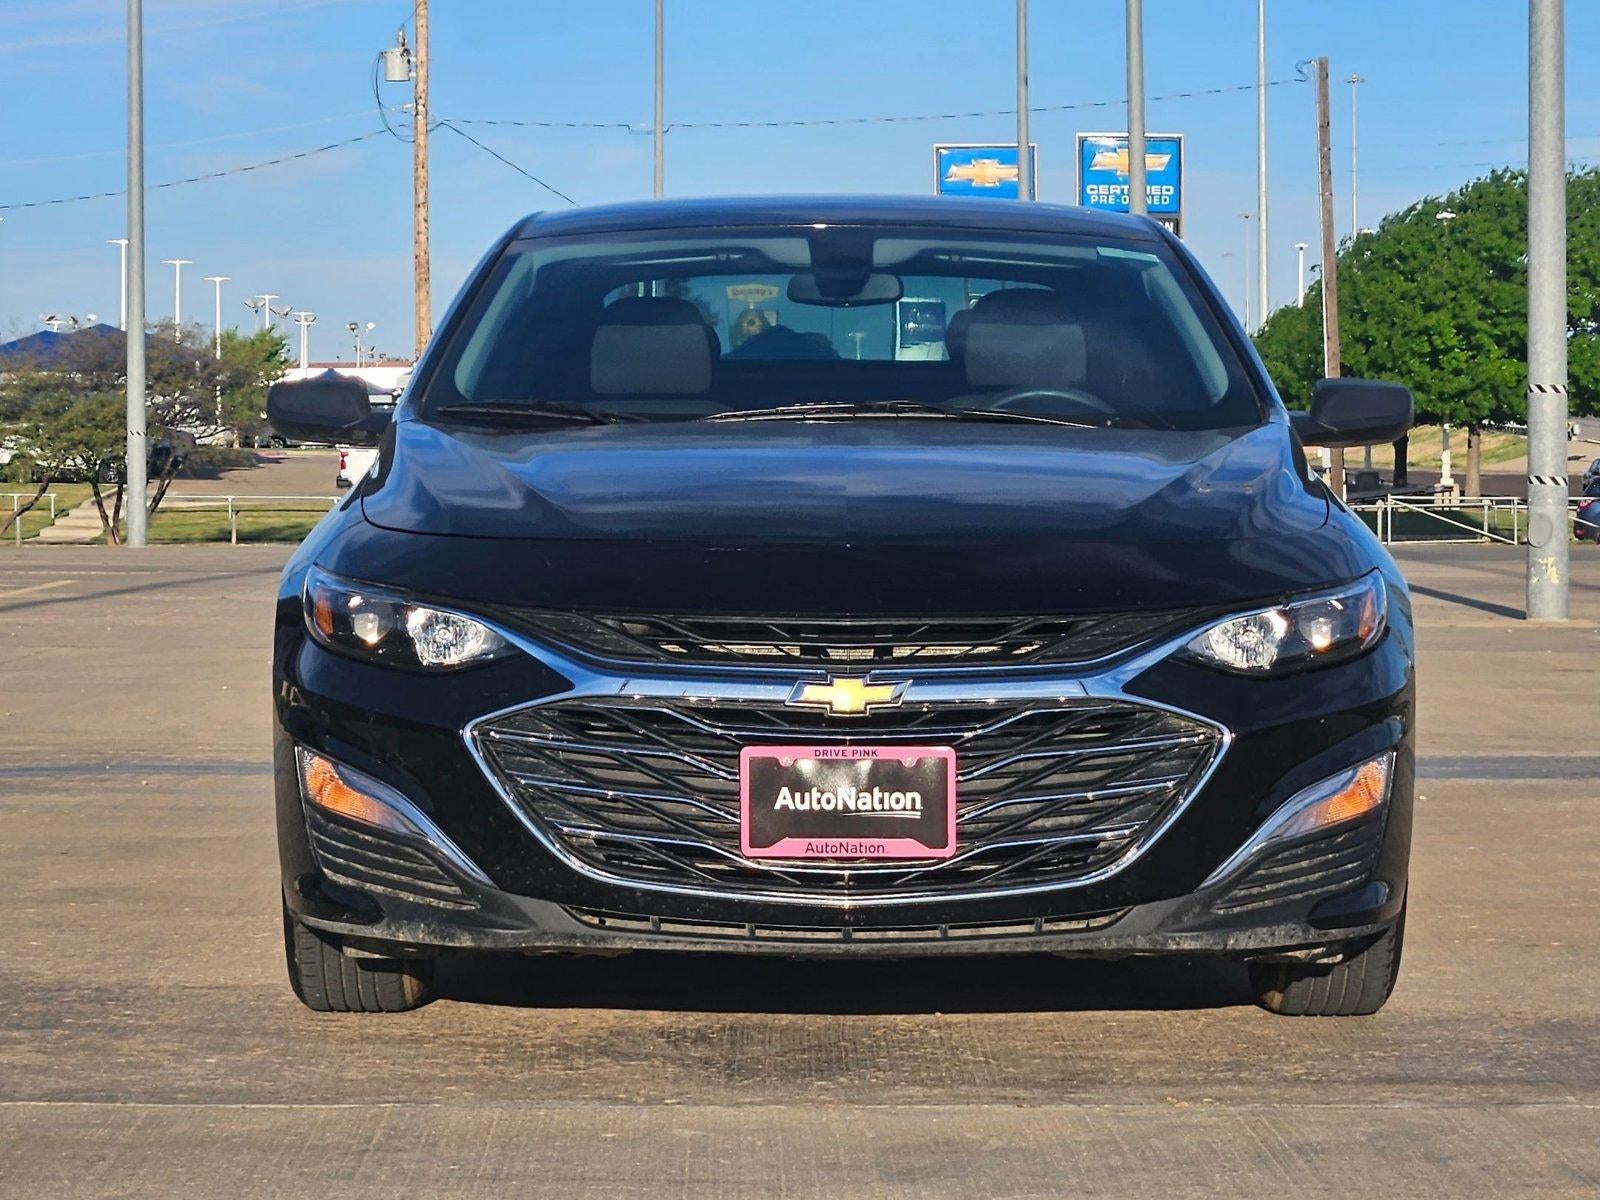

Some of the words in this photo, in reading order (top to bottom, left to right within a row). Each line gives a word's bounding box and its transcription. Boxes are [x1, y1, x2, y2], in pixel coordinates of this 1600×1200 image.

[1086, 184, 1174, 196] CERTIED
[1090, 195, 1170, 205] PRE-ONED
[814, 749, 848, 758] DRIVE
[852, 749, 879, 758] PINK
[774, 786, 923, 810] AutoNation
[805, 841, 885, 855] AutoNation
